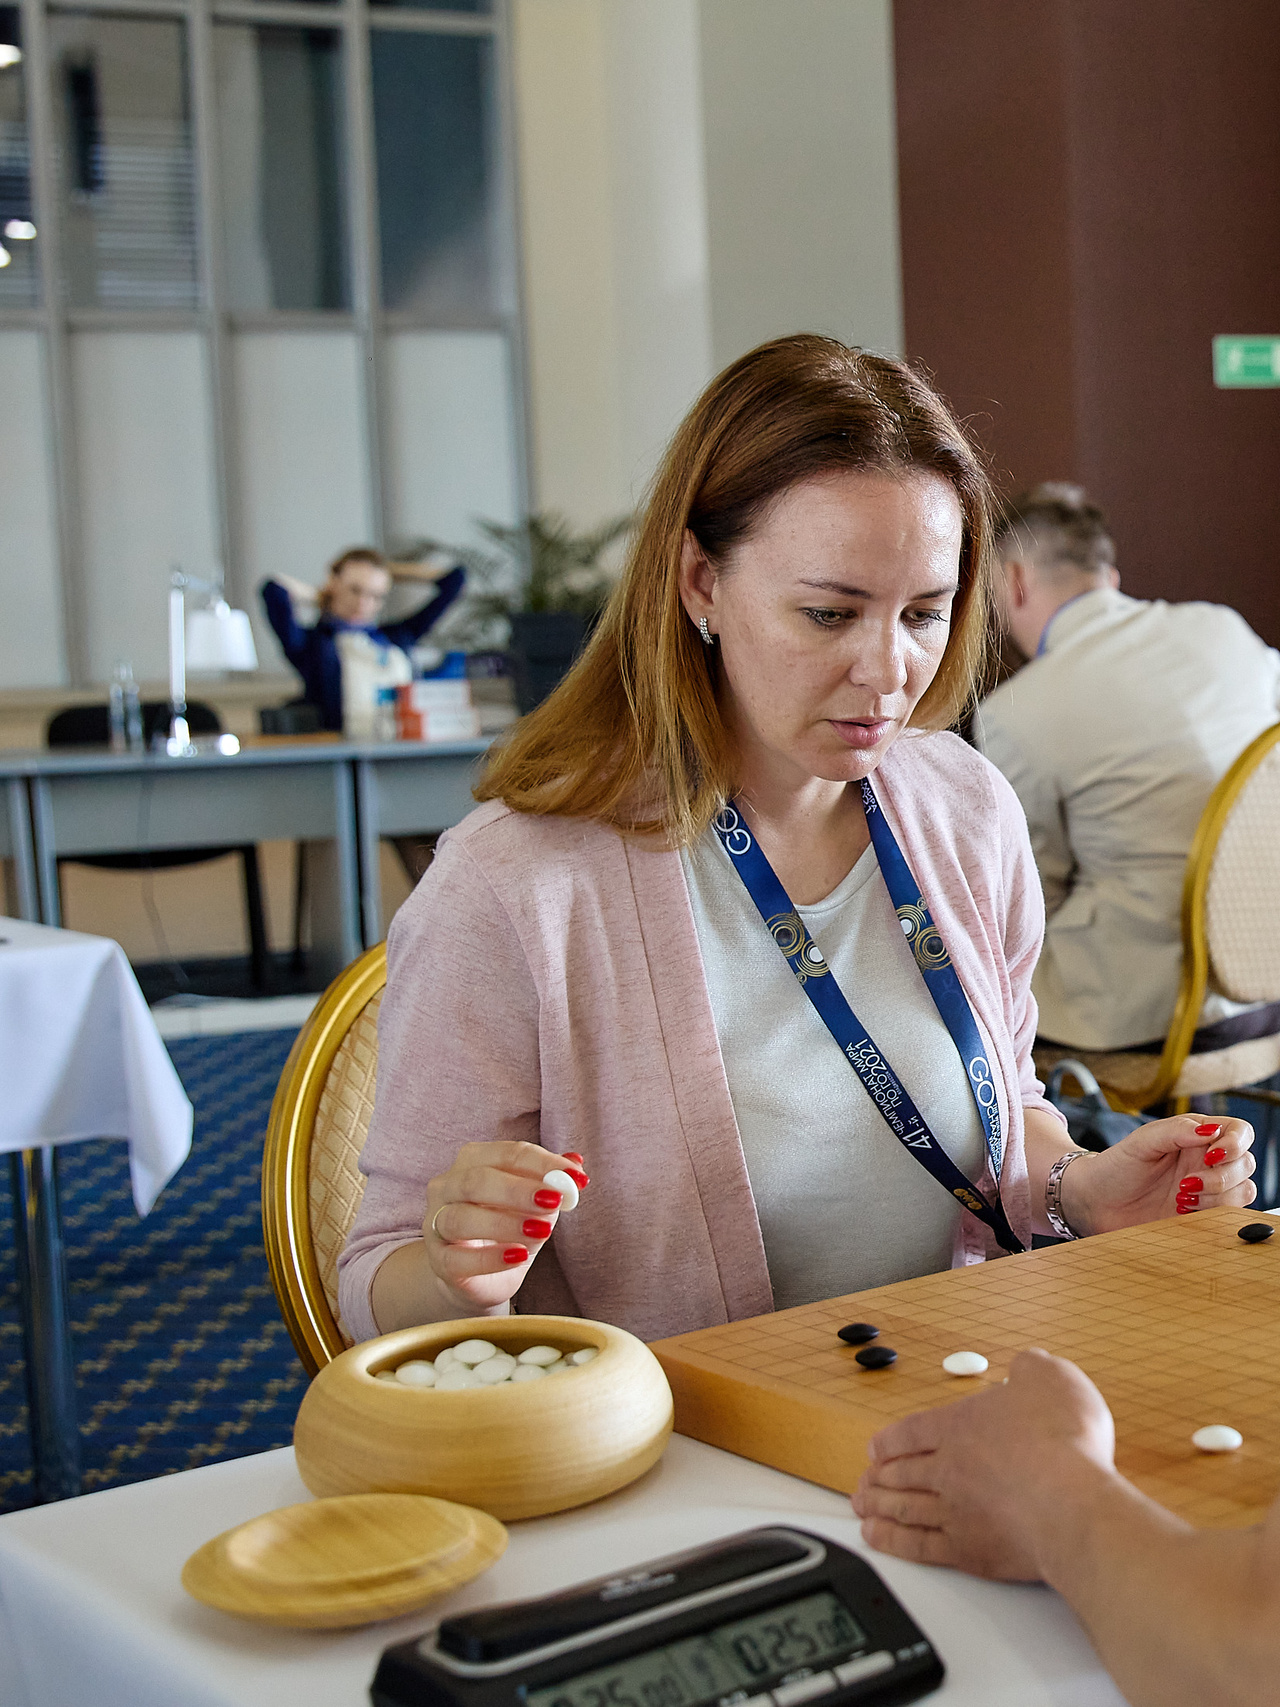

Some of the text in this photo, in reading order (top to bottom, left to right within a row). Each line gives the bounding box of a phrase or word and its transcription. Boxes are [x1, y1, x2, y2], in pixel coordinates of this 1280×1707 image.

[714, 806, 751, 855] GO
[845, 1042, 906, 1136] ЧЕМПИОНАТ МИРА
[969, 1056, 996, 1107] GO
